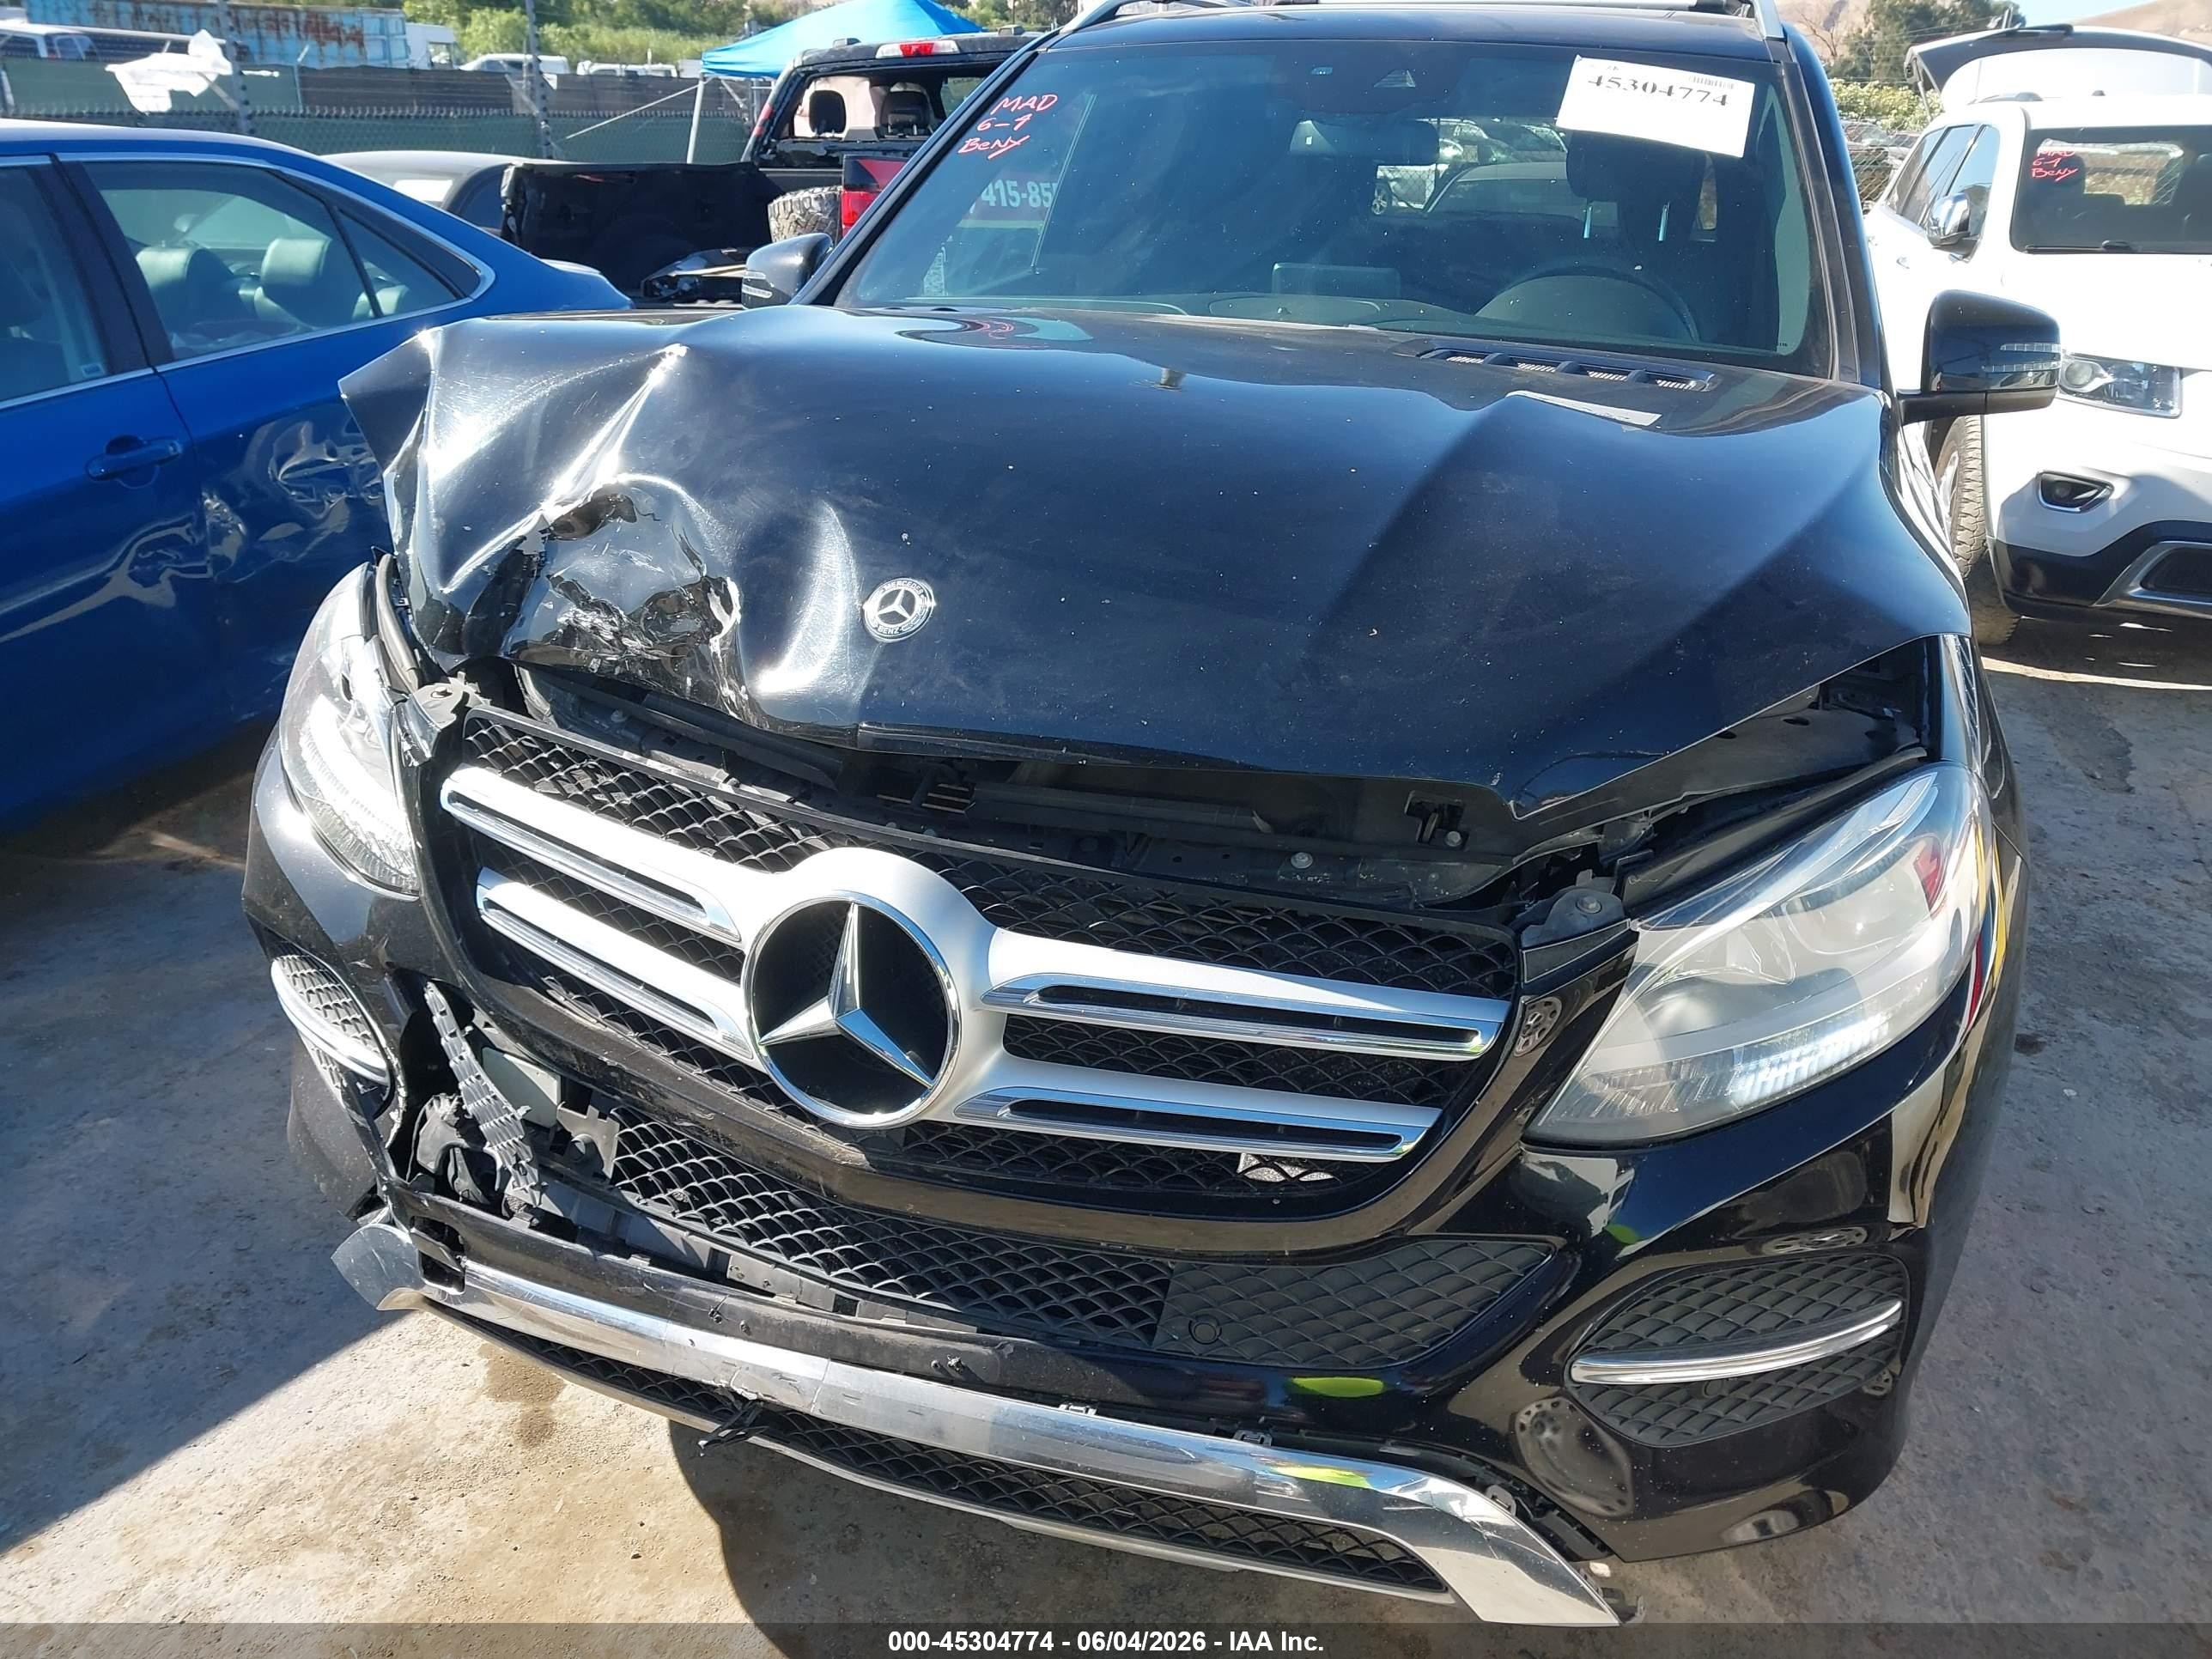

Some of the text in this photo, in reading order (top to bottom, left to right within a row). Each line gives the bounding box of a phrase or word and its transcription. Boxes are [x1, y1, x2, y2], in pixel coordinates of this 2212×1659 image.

[1588, 75, 1728, 106] 45304774
[990, 94, 1058, 115] MAD
[884, 580, 925, 597] MERCEDES
[877, 623, 901, 635] BENZ
